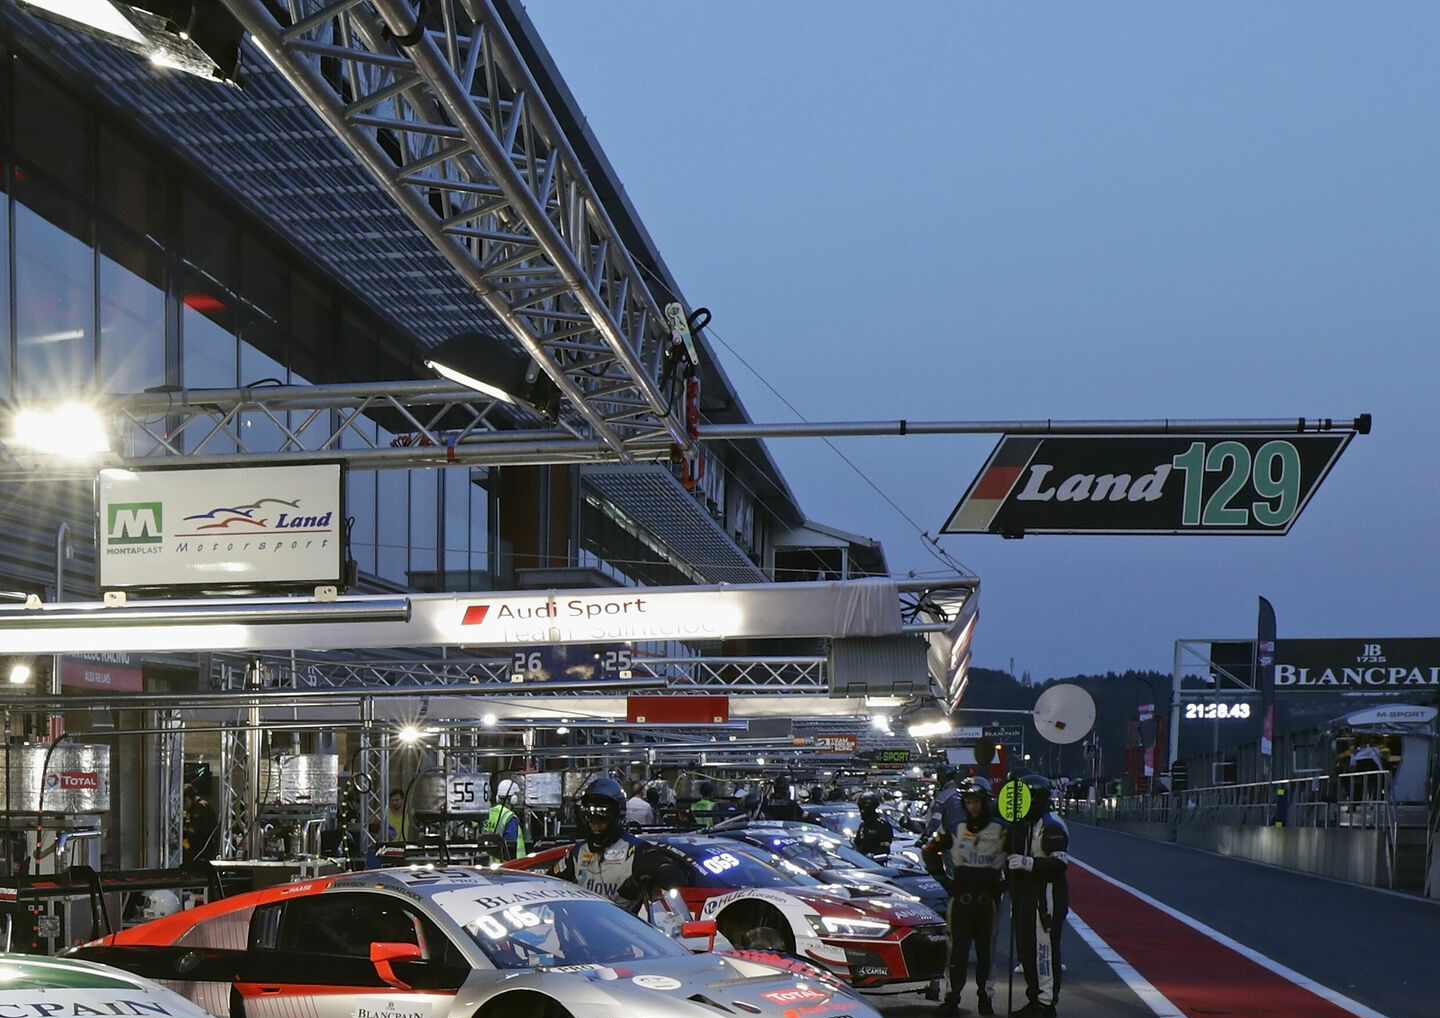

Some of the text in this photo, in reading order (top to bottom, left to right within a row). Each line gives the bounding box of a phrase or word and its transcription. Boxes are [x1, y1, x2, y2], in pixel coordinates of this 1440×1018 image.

[1017, 439, 1302, 527] Land 129
[275, 511, 332, 530] Land
[106, 546, 163, 555] MONTAPLAST
[175, 538, 330, 553] Motorsport
[498, 598, 648, 620] Audi Sport
[514, 652, 543, 674] 26
[605, 650, 632, 672] 25
[63, 775, 97, 786] TOTAL
[453, 782, 475, 803] 55
[1005, 784, 1015, 820] START
[703, 852, 740, 875] 069
[289, 884, 313, 894] HAASE
[765, 988, 825, 1003] TOTAL
